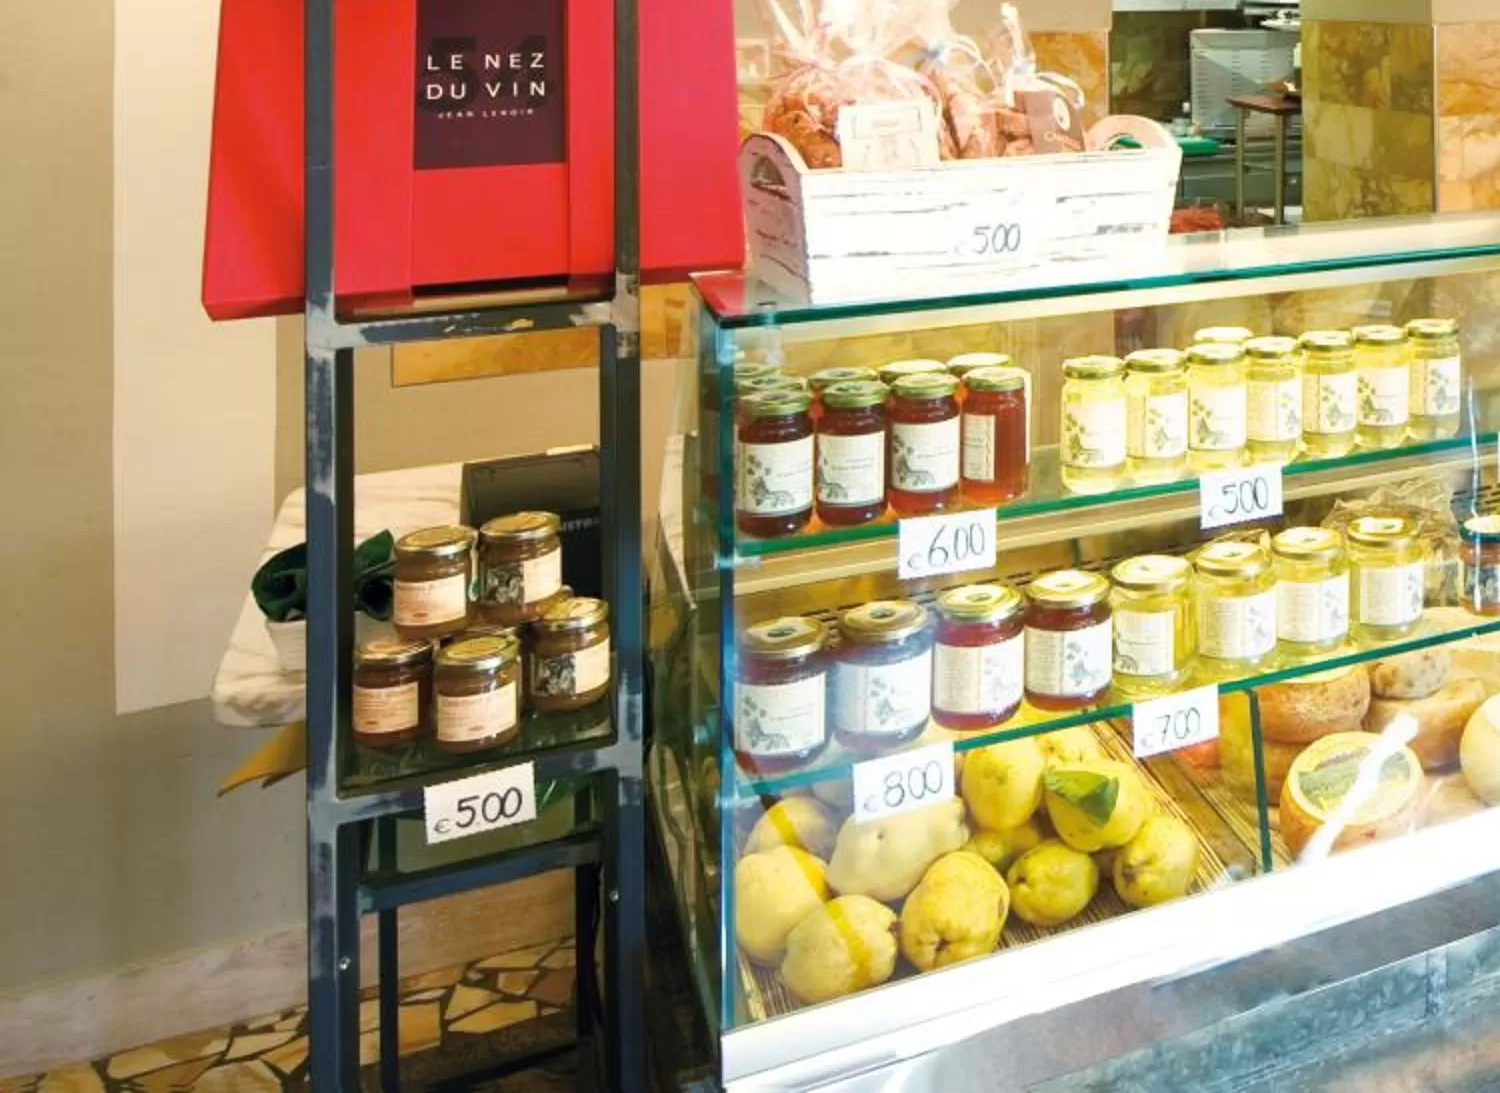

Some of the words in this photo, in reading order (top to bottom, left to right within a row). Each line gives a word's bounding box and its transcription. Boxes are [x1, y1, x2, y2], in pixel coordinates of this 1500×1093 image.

[426, 53, 465, 72] LE
[484, 51, 546, 70] NEZ
[426, 82, 467, 101] DU
[484, 80, 547, 98] VIN
